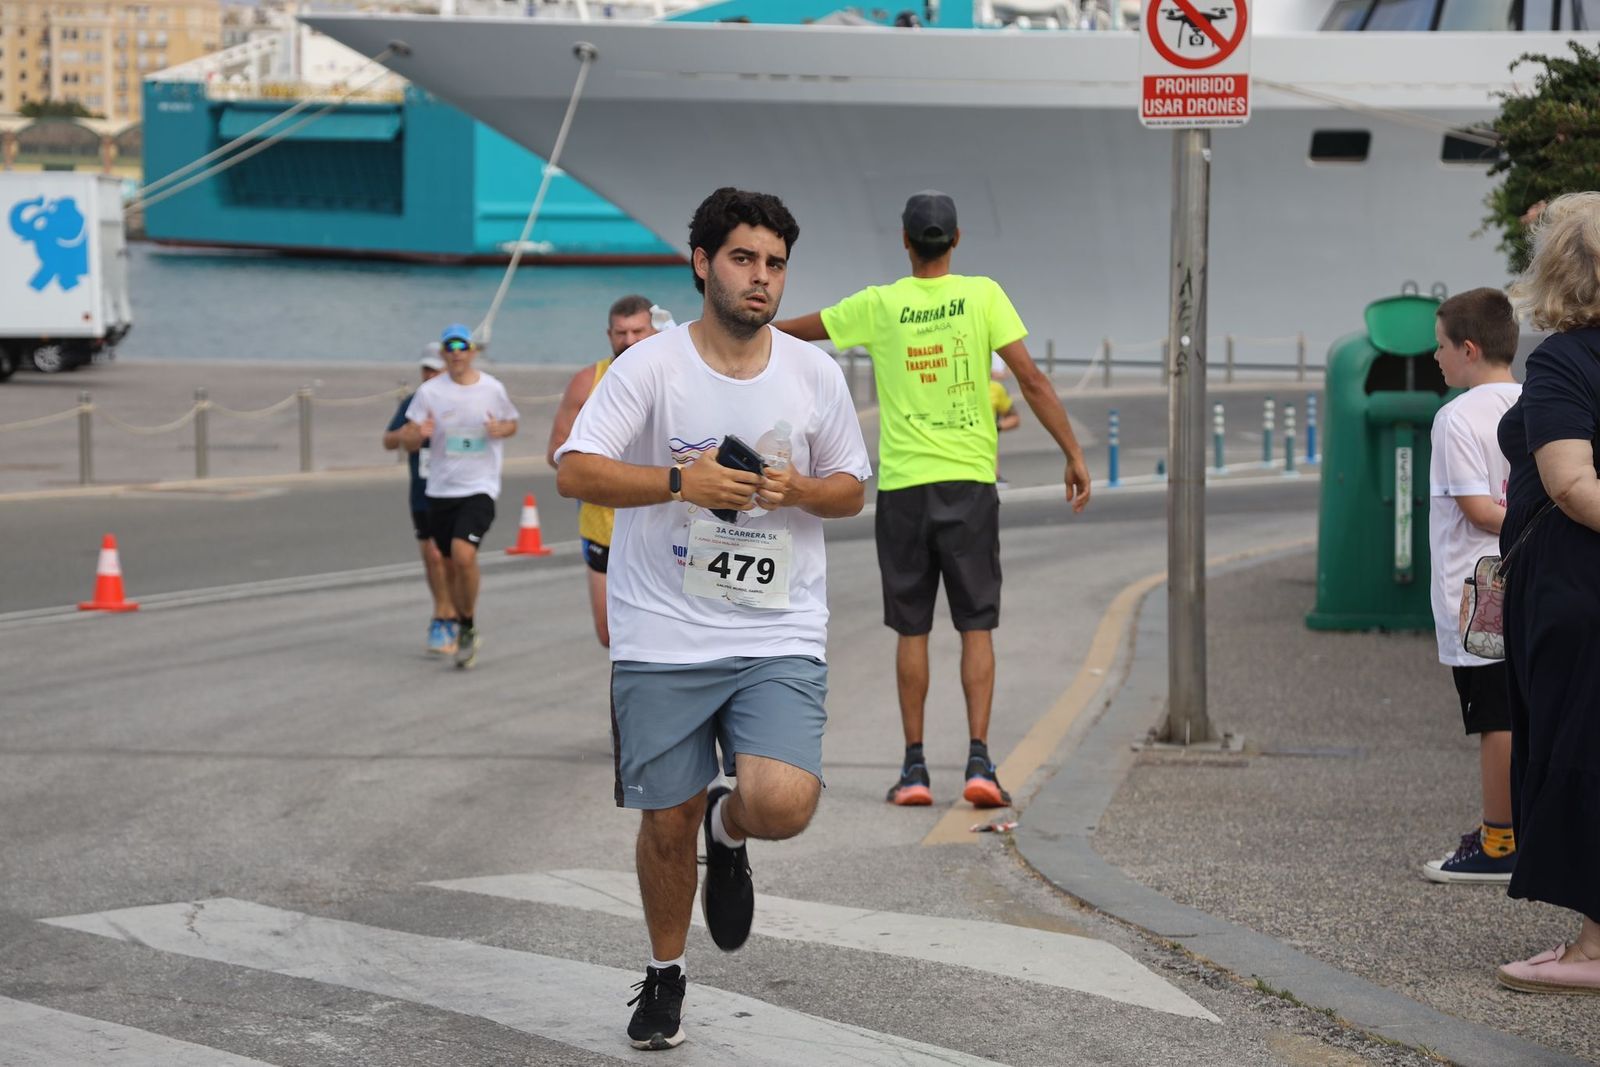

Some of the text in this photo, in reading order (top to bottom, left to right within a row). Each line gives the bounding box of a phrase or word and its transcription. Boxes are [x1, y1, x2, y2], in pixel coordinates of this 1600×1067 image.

[1155, 77, 1235, 95] PROHIBIDO
[1144, 96, 1246, 115] USAR DRONES
[948, 298, 966, 317] 5K
[728, 529, 767, 540] CARRERA
[768, 533, 778, 541] 5K
[707, 551, 775, 585] 479
